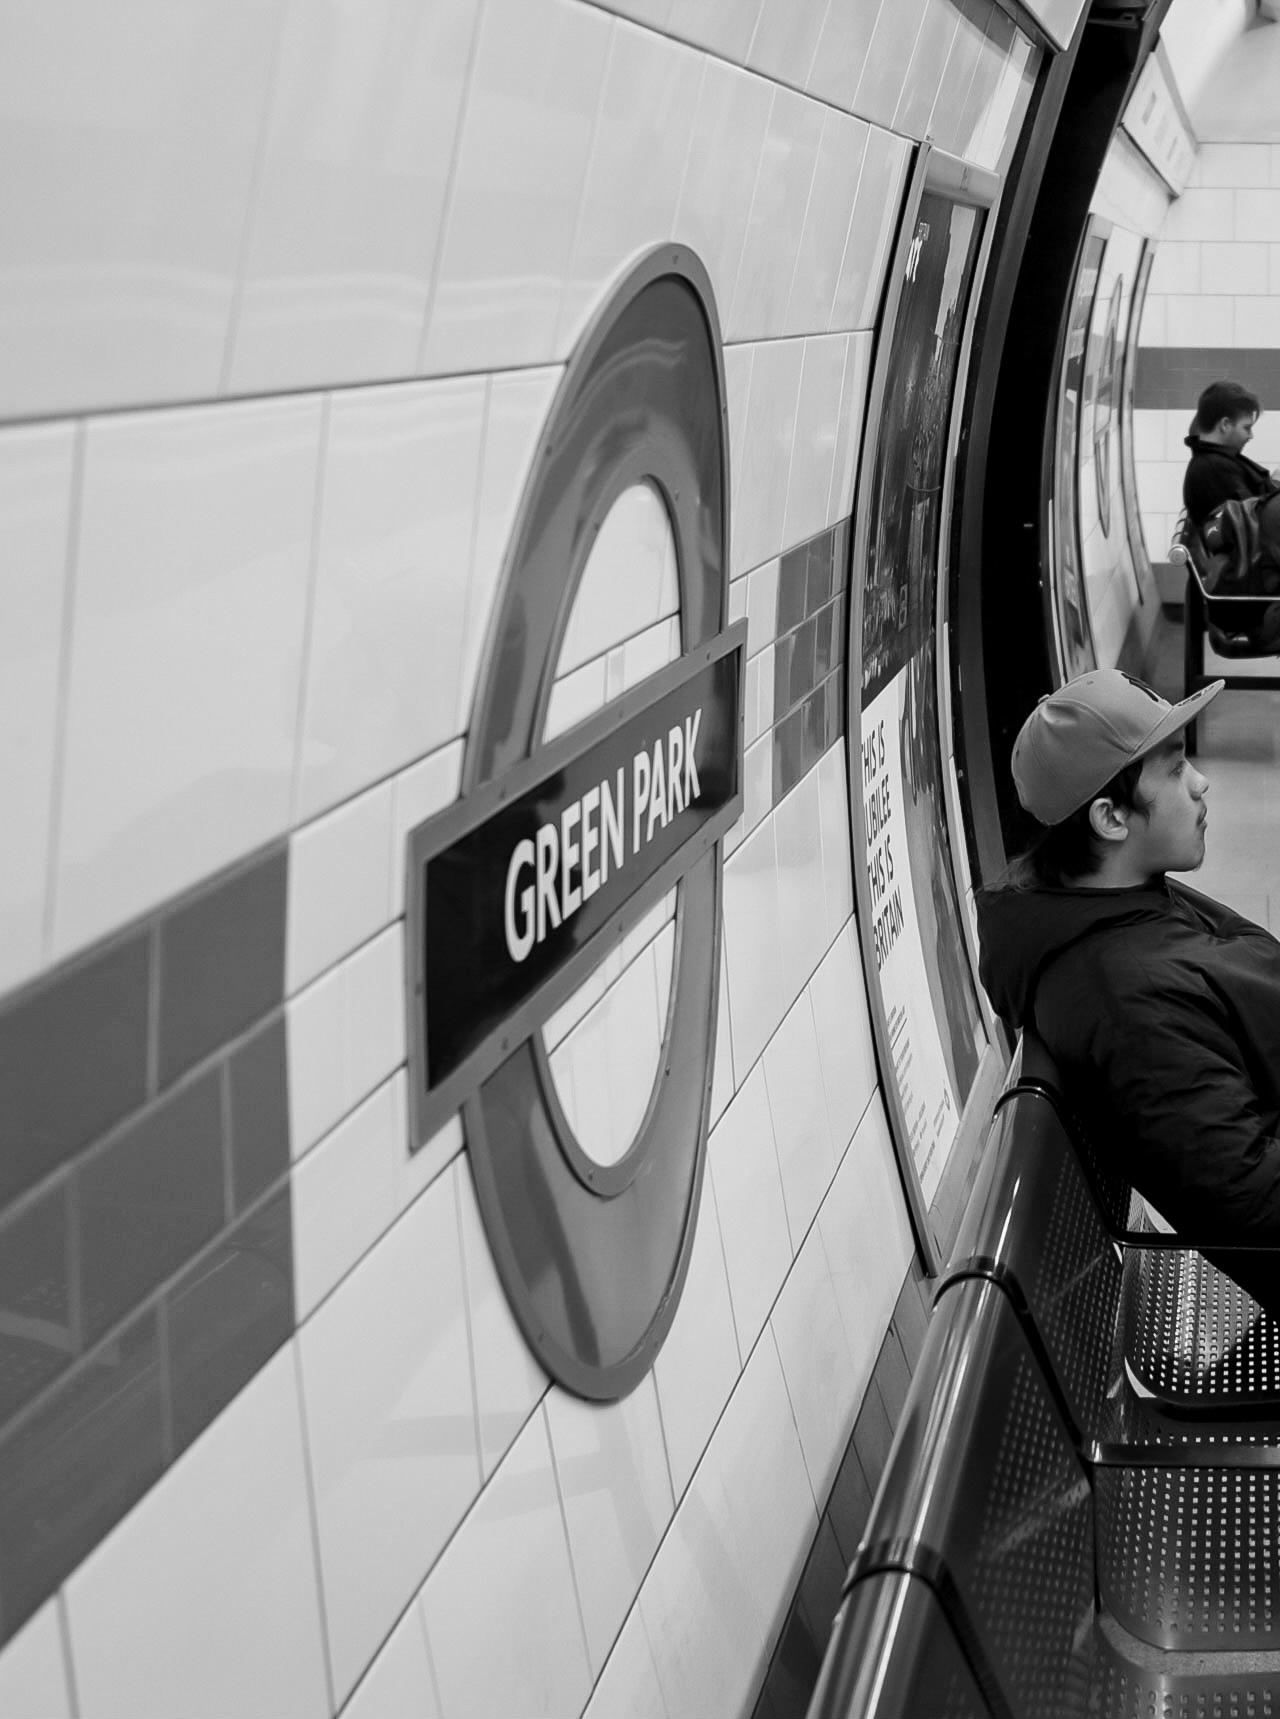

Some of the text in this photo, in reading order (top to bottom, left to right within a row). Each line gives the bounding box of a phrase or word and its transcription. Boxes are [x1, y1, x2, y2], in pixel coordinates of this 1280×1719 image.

[861, 719, 886, 788] HIS IS
[504, 708, 702, 963] GREEN PARK
[865, 773, 892, 848] UBILEE
[884, 833, 894, 884] IS
